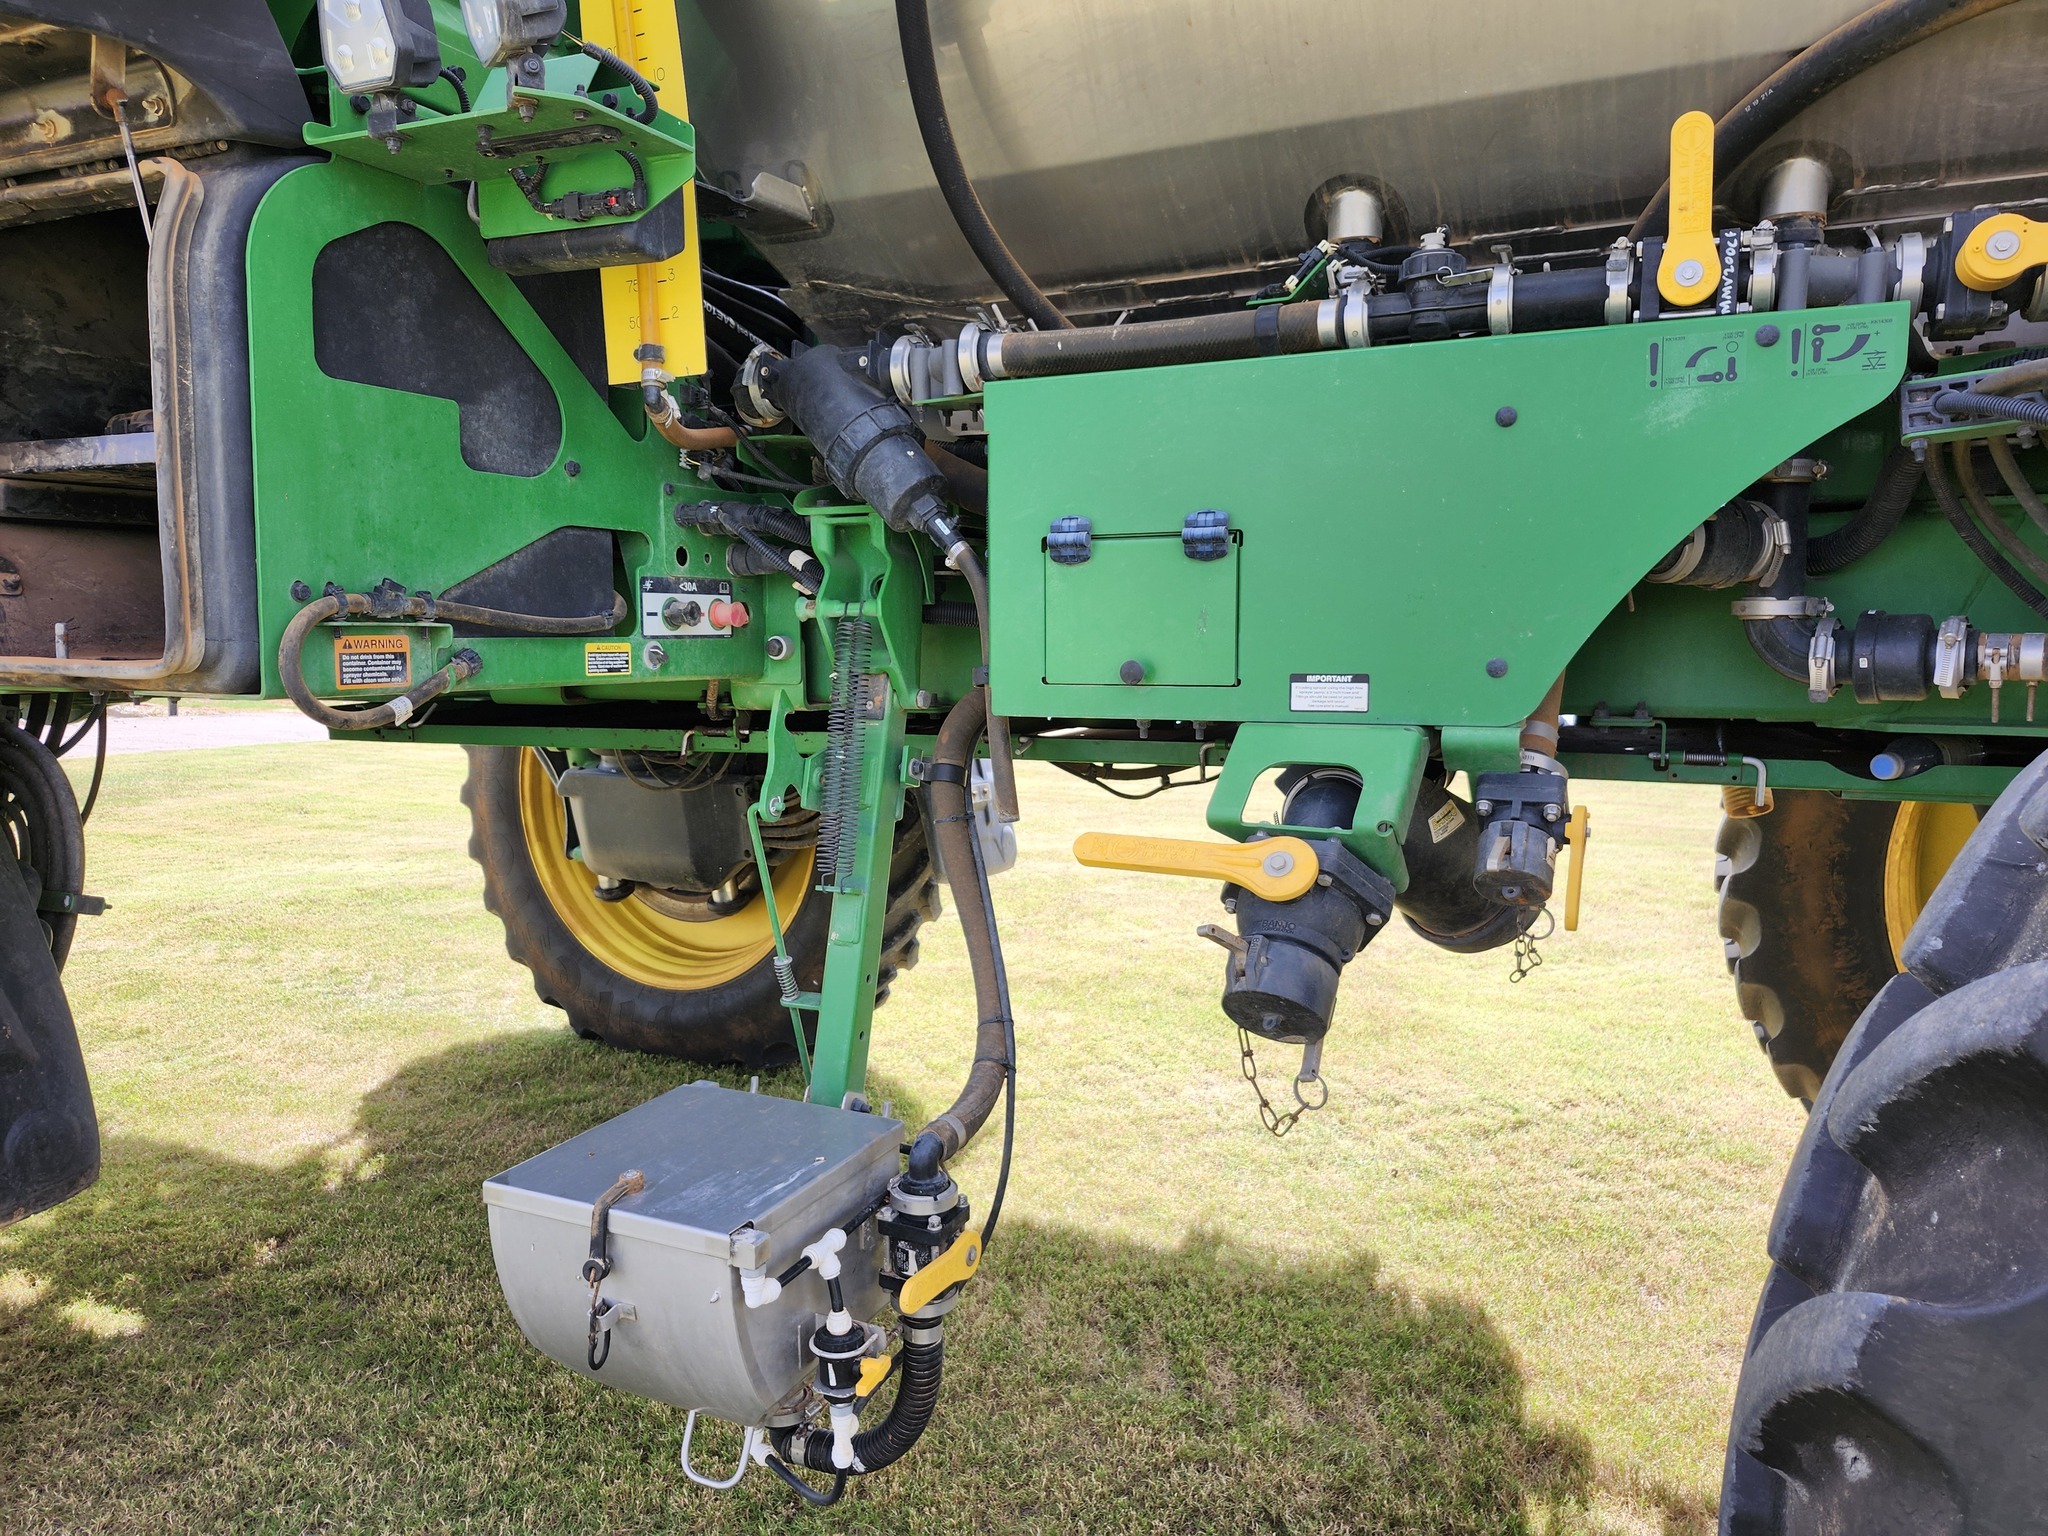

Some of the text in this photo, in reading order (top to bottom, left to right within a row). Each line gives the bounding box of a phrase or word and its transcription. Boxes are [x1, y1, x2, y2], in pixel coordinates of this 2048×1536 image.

[654, 67, 666, 82] 10
[668, 268, 676, 281] 3
[672, 306, 679, 318] 2
[354, 639, 403, 649] WARNING
[1262, 920, 1296, 930] BANJO
